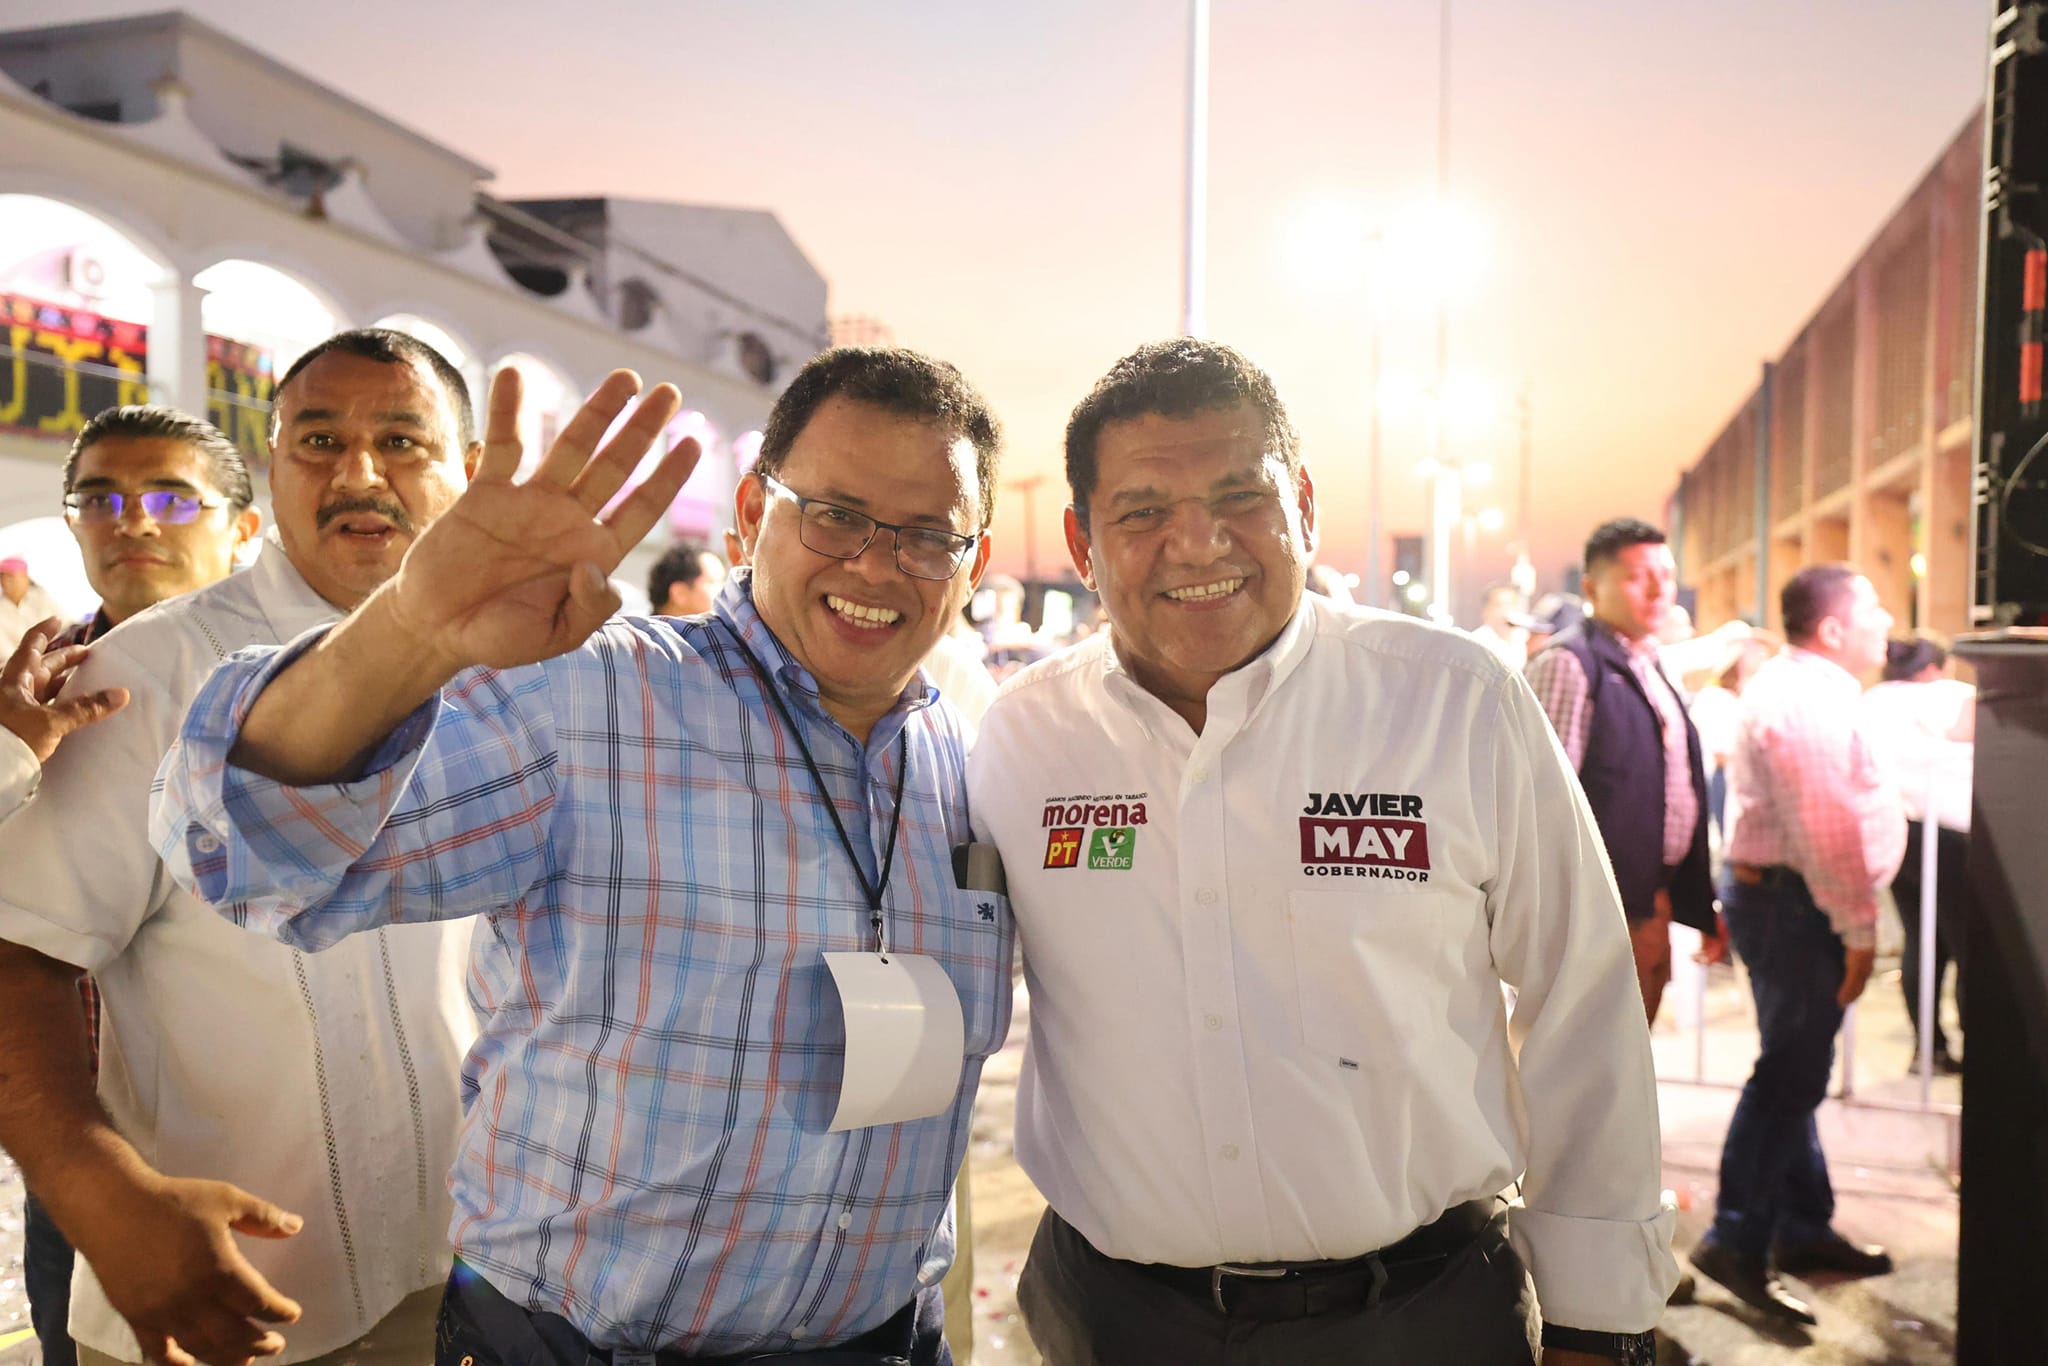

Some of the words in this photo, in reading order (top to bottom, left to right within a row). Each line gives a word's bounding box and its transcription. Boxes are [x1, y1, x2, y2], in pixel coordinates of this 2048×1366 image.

[1042, 802, 1148, 827] morena
[1303, 792, 1423, 818] JAVIER
[1047, 841, 1078, 865] PT
[1313, 825, 1414, 861] MAY
[1092, 855, 1131, 868] VERDE
[1303, 865, 1429, 883] GOBERNADOR
